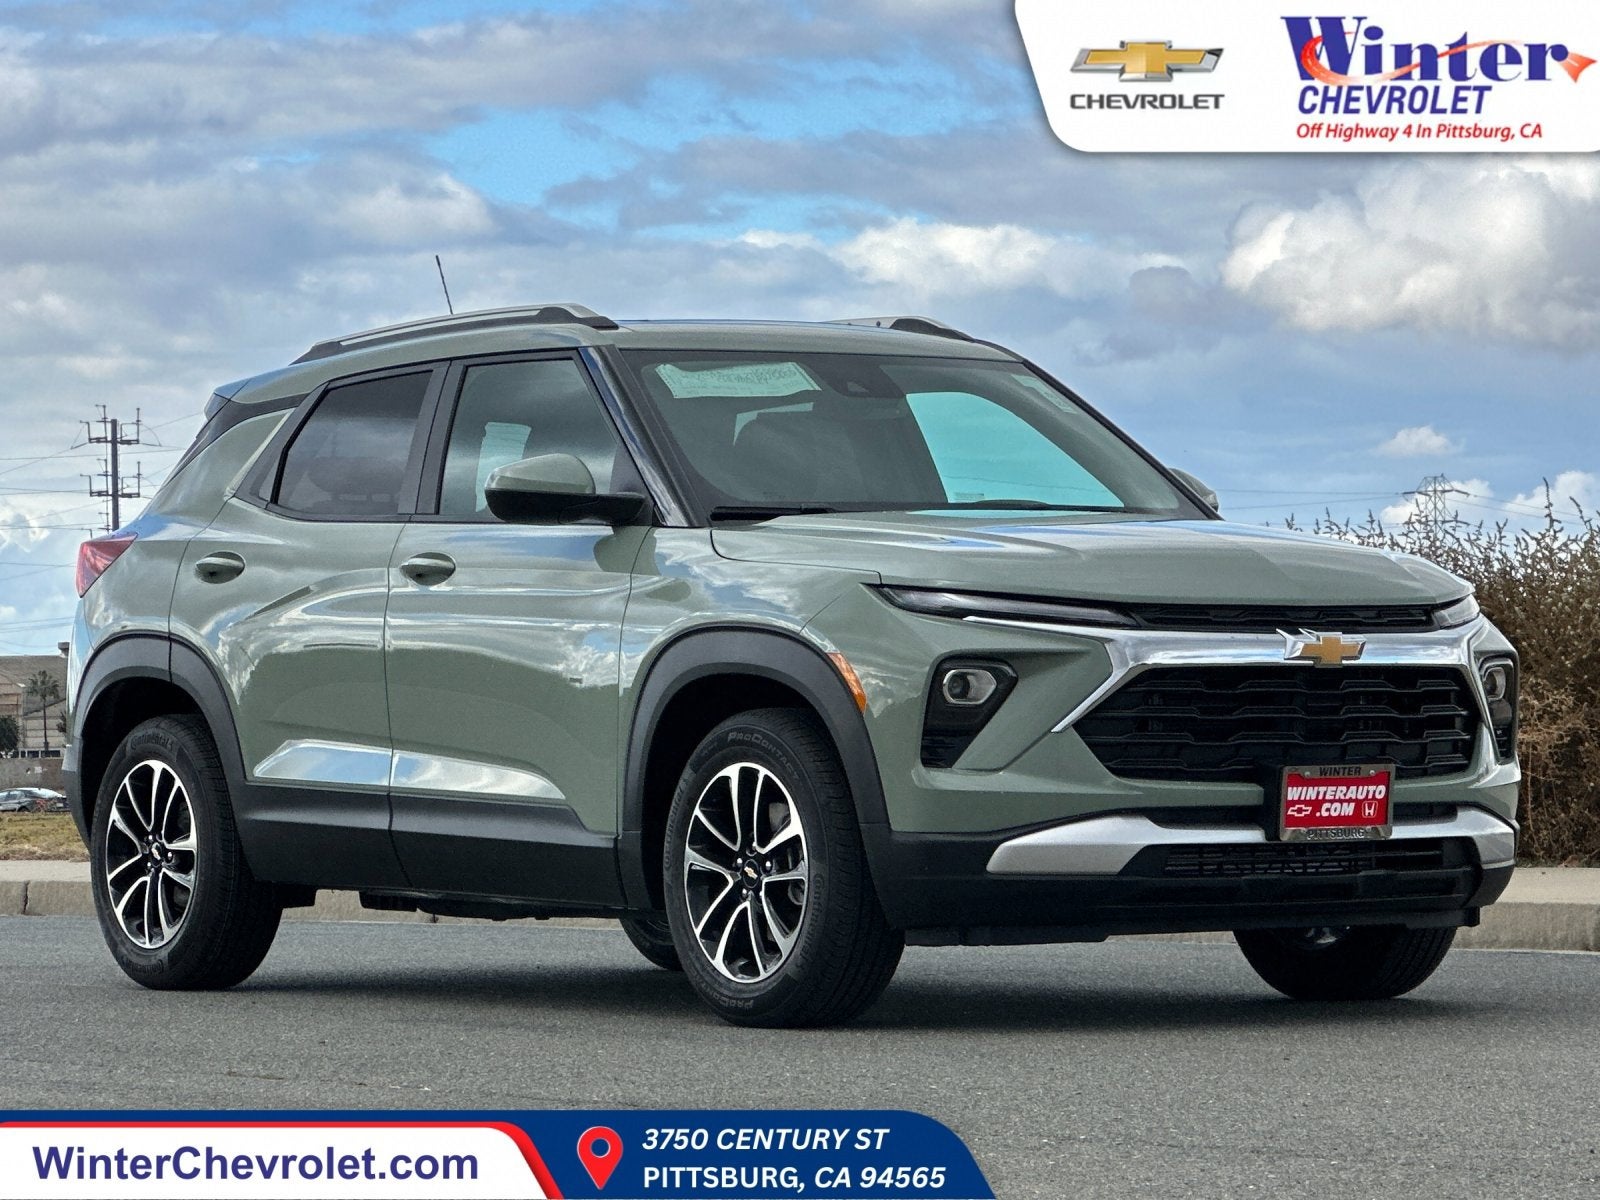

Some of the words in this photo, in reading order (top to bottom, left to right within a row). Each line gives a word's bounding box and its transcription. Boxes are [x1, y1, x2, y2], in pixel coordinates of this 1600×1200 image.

[1319, 766, 1361, 777] WINTER
[1287, 785, 1387, 801] WINTERAUTO
[1315, 802, 1356, 817] .COM
[1305, 827, 1365, 840] PITTSBURG
